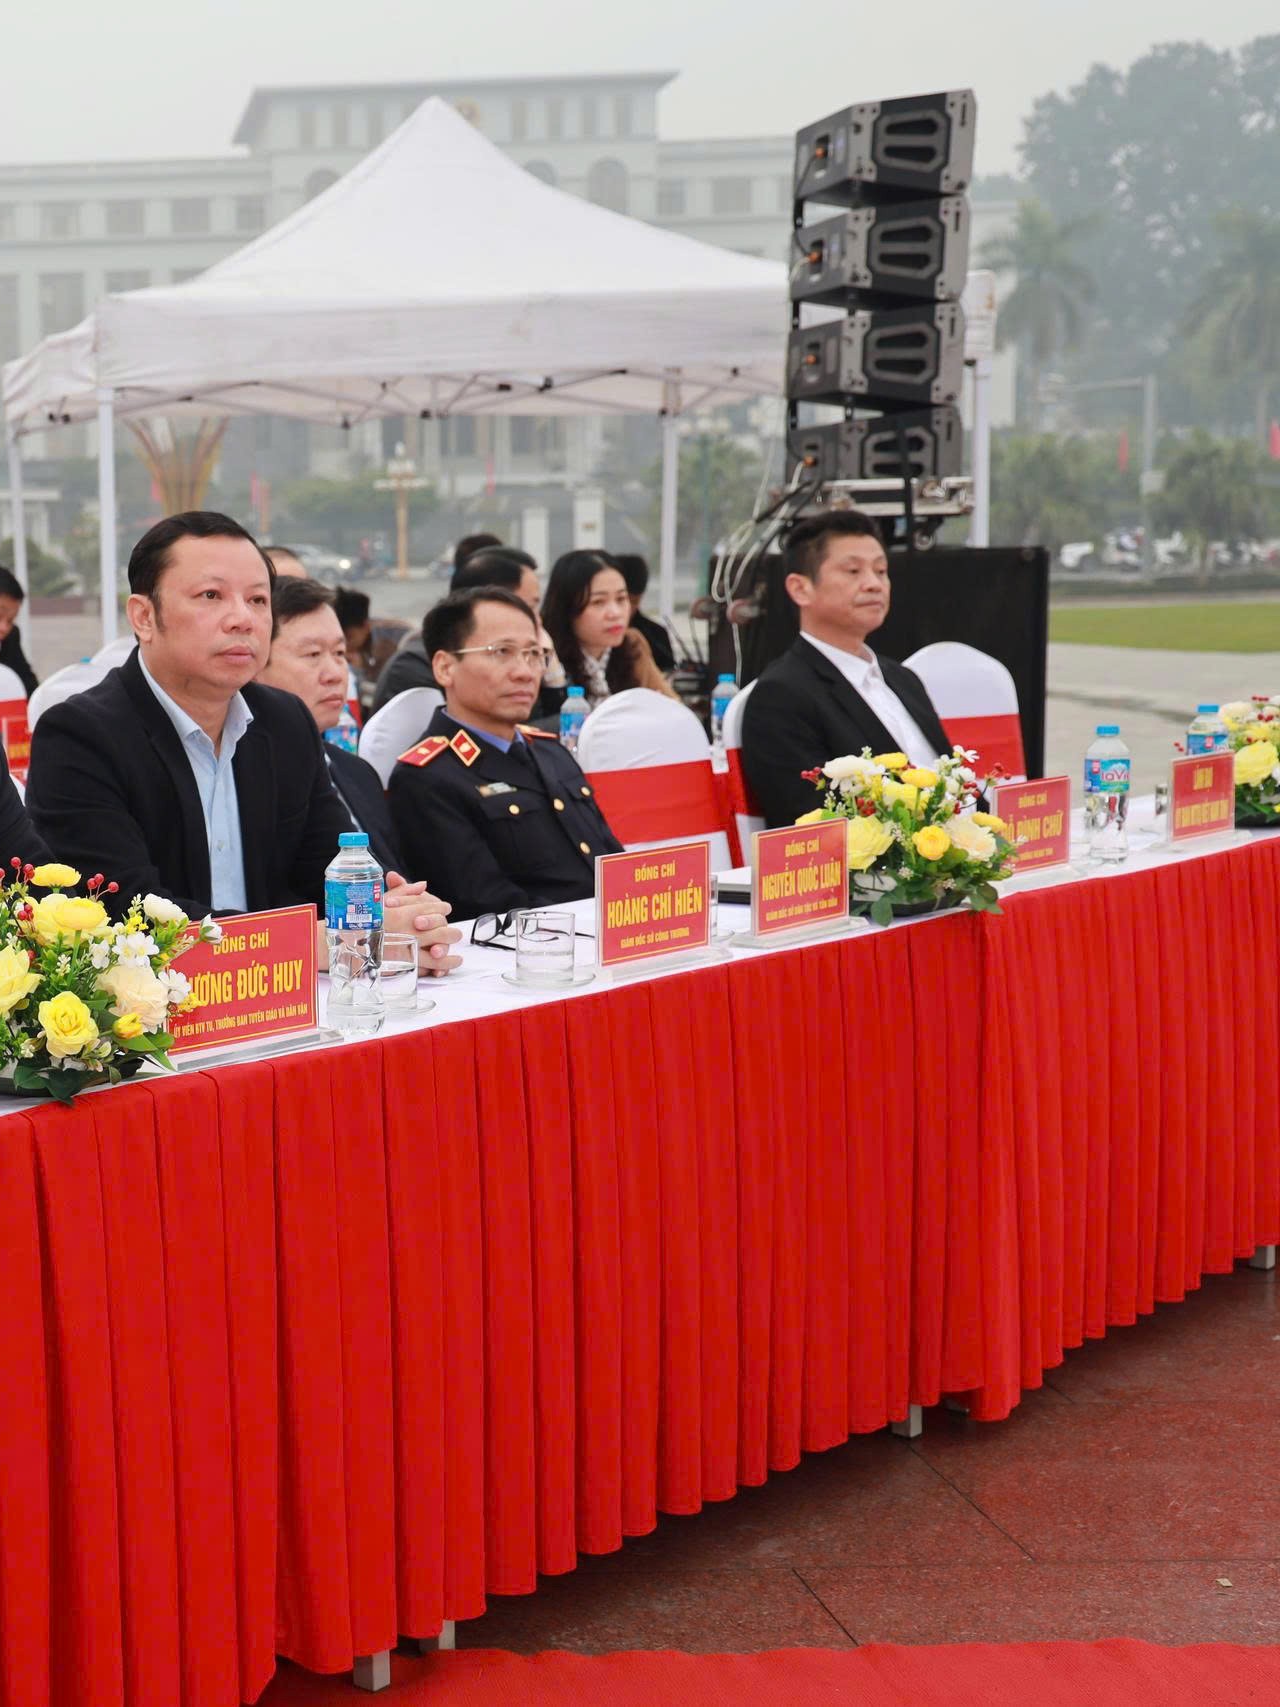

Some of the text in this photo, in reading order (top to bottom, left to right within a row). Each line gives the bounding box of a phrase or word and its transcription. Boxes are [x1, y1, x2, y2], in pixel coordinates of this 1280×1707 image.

[1101, 768, 1130, 781] laVi
[661, 860, 675, 878] CHÍ
[607, 893, 648, 929] HOÀNG
[652, 885, 672, 921] CHÍ
[250, 928, 269, 950] CHÍ
[189, 959, 303, 1007] ƯƠNG ĐỨC HUY
